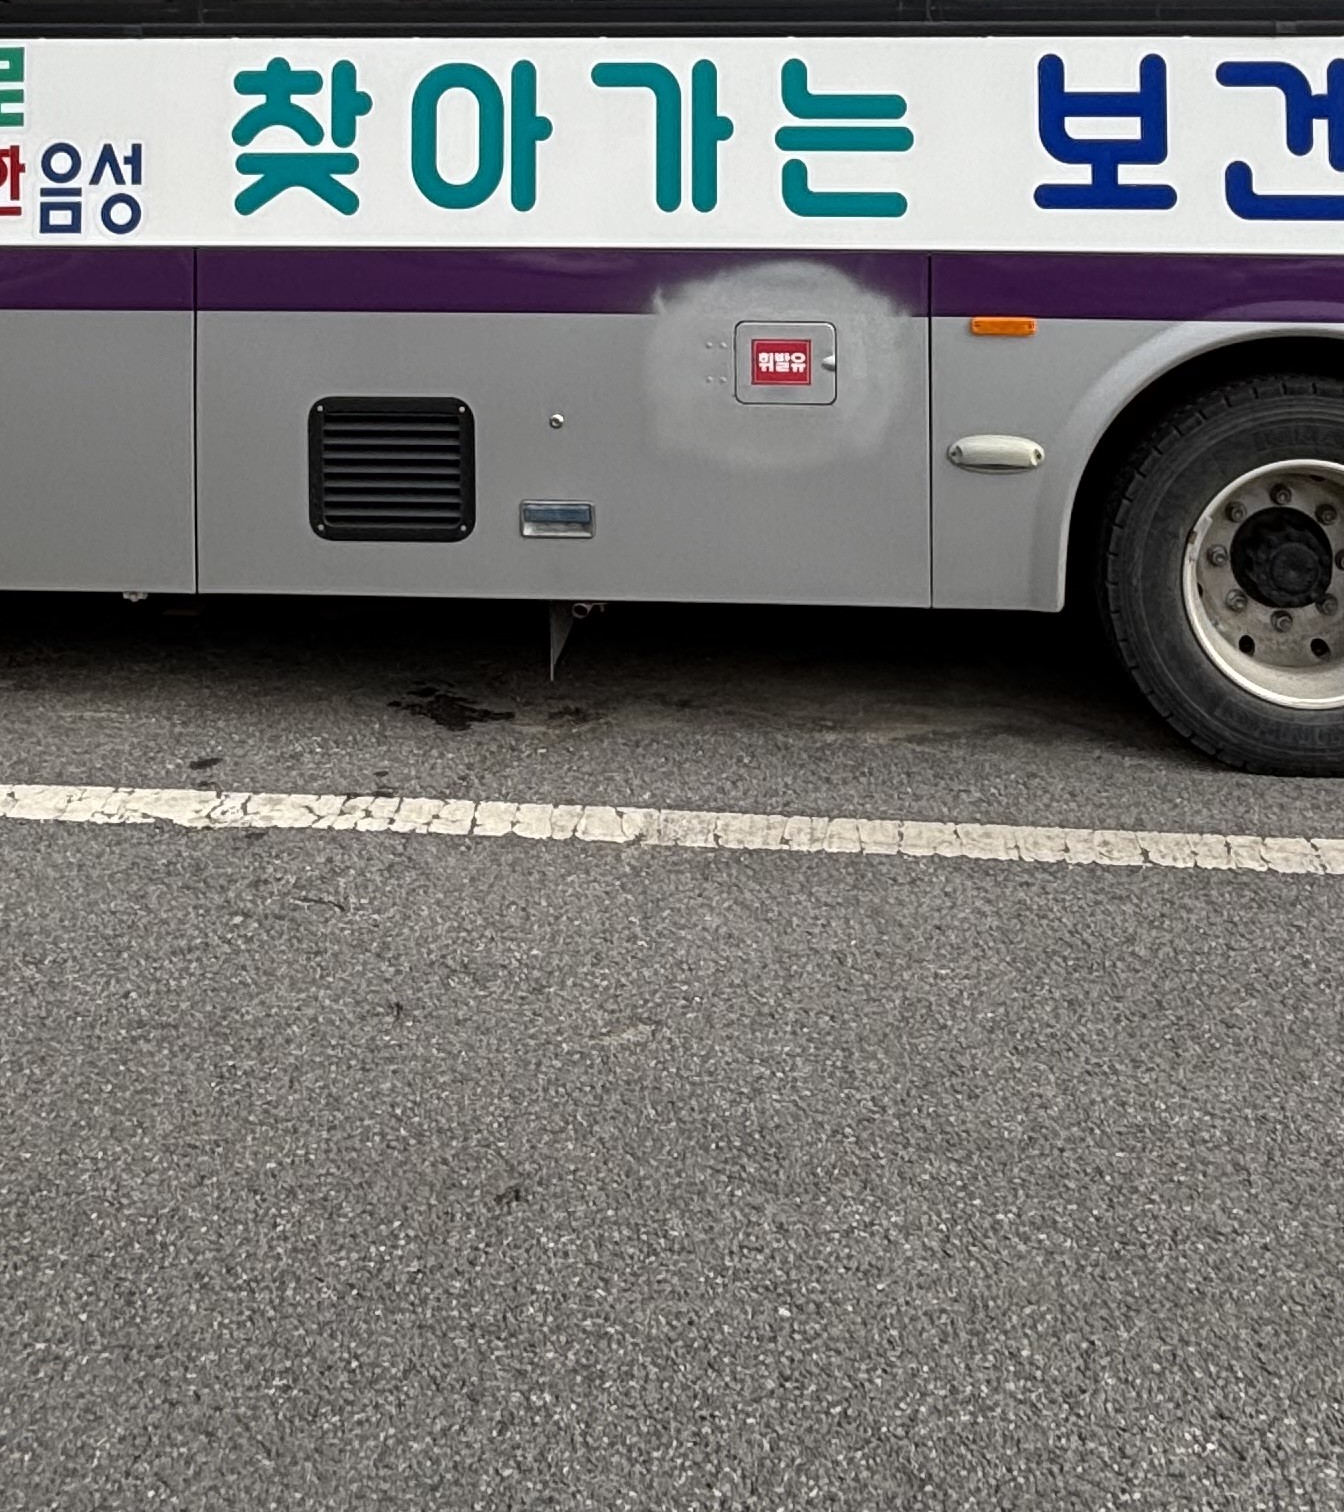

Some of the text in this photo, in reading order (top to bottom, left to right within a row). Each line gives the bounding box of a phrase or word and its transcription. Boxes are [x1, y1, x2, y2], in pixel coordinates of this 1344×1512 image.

[230, 57, 915, 219] 찾아가는
[39, 141, 143, 235] 음성
[758, 352, 807, 373] 휘발유
